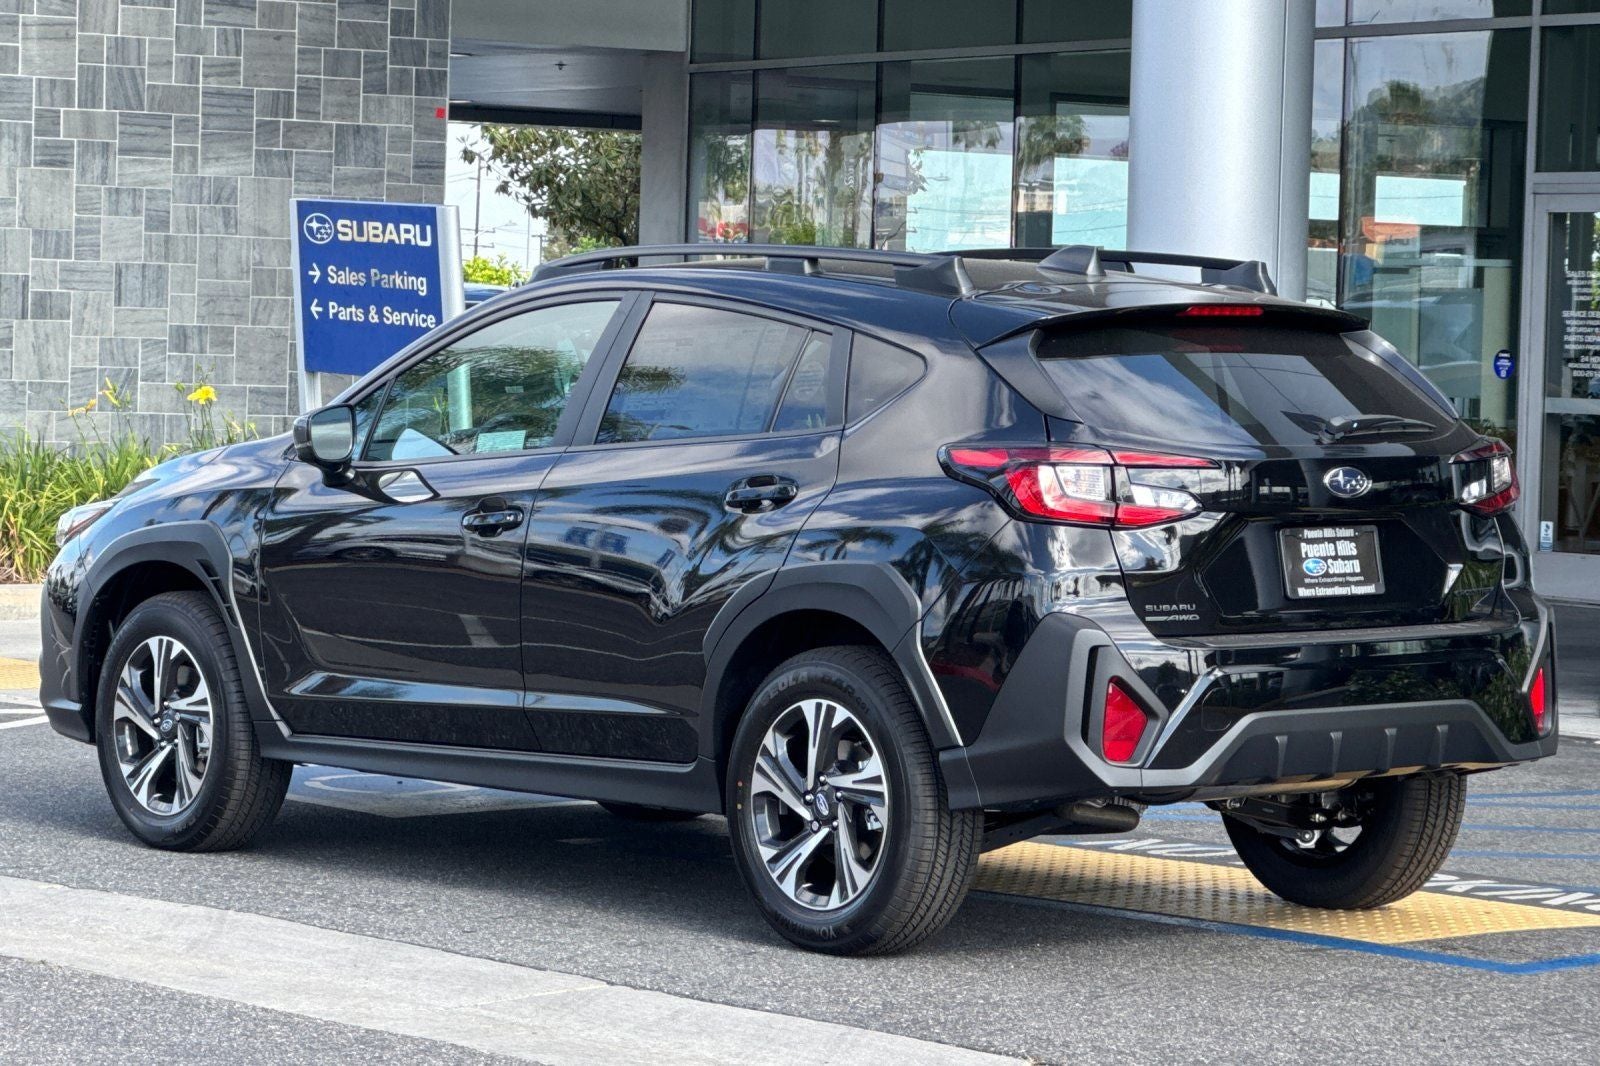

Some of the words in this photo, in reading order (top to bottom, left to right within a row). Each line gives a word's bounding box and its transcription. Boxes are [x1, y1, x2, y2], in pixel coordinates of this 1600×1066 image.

[336, 219, 432, 247] SUBARU
[327, 265, 367, 287] Sales
[370, 268, 427, 297] Parking
[328, 301, 365, 323] Parts
[368, 305, 379, 324] &
[382, 305, 437, 329] Service
[1300, 541, 1336, 558] Puente
[1335, 540, 1358, 556] Hills
[1327, 558, 1360, 574] Subaru
[1297, 587, 1316, 597] Where
[1145, 603, 1196, 612] SUBARU
